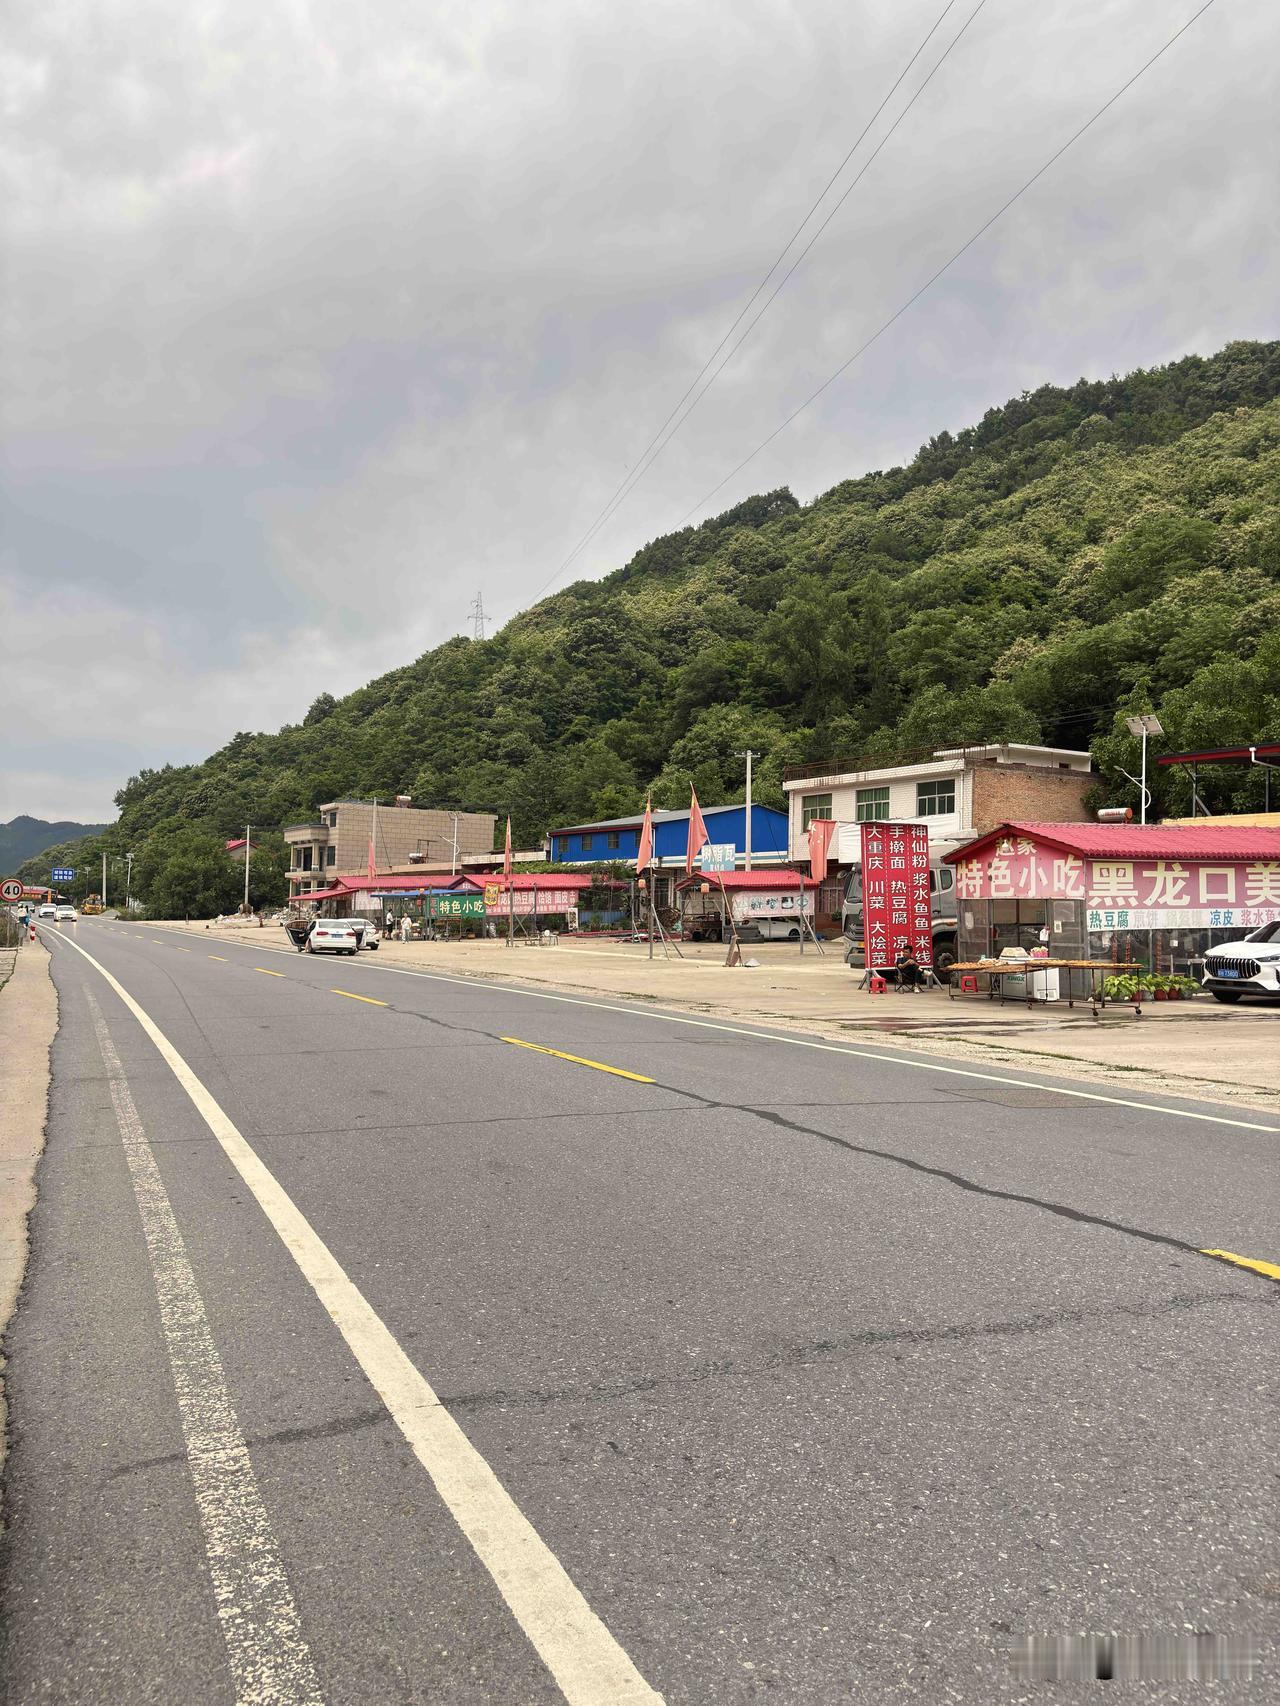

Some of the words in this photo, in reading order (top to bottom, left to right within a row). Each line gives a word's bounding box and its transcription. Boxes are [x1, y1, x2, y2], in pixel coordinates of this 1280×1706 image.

[867, 825, 884, 869] 大重庆
[889, 825, 906, 869] 手擀面
[911, 825, 928, 868] 神仙粉
[4, 885, 20, 896] 40
[869, 880, 885, 910] 川菜
[957, 854, 1085, 898] 特色小吃
[1088, 861, 1280, 907] 黑龙口美
[439, 900, 484, 914] 特色小吃
[890, 880, 907, 925] 热豆腐
[913, 872, 930, 931] 浆水鱼鱼
[1089, 910, 1129, 929] 热豆腐
[1210, 910, 1234, 926] 凉皮
[870, 921, 887, 965] 大烩菜
[915, 935, 931, 964] 米线
